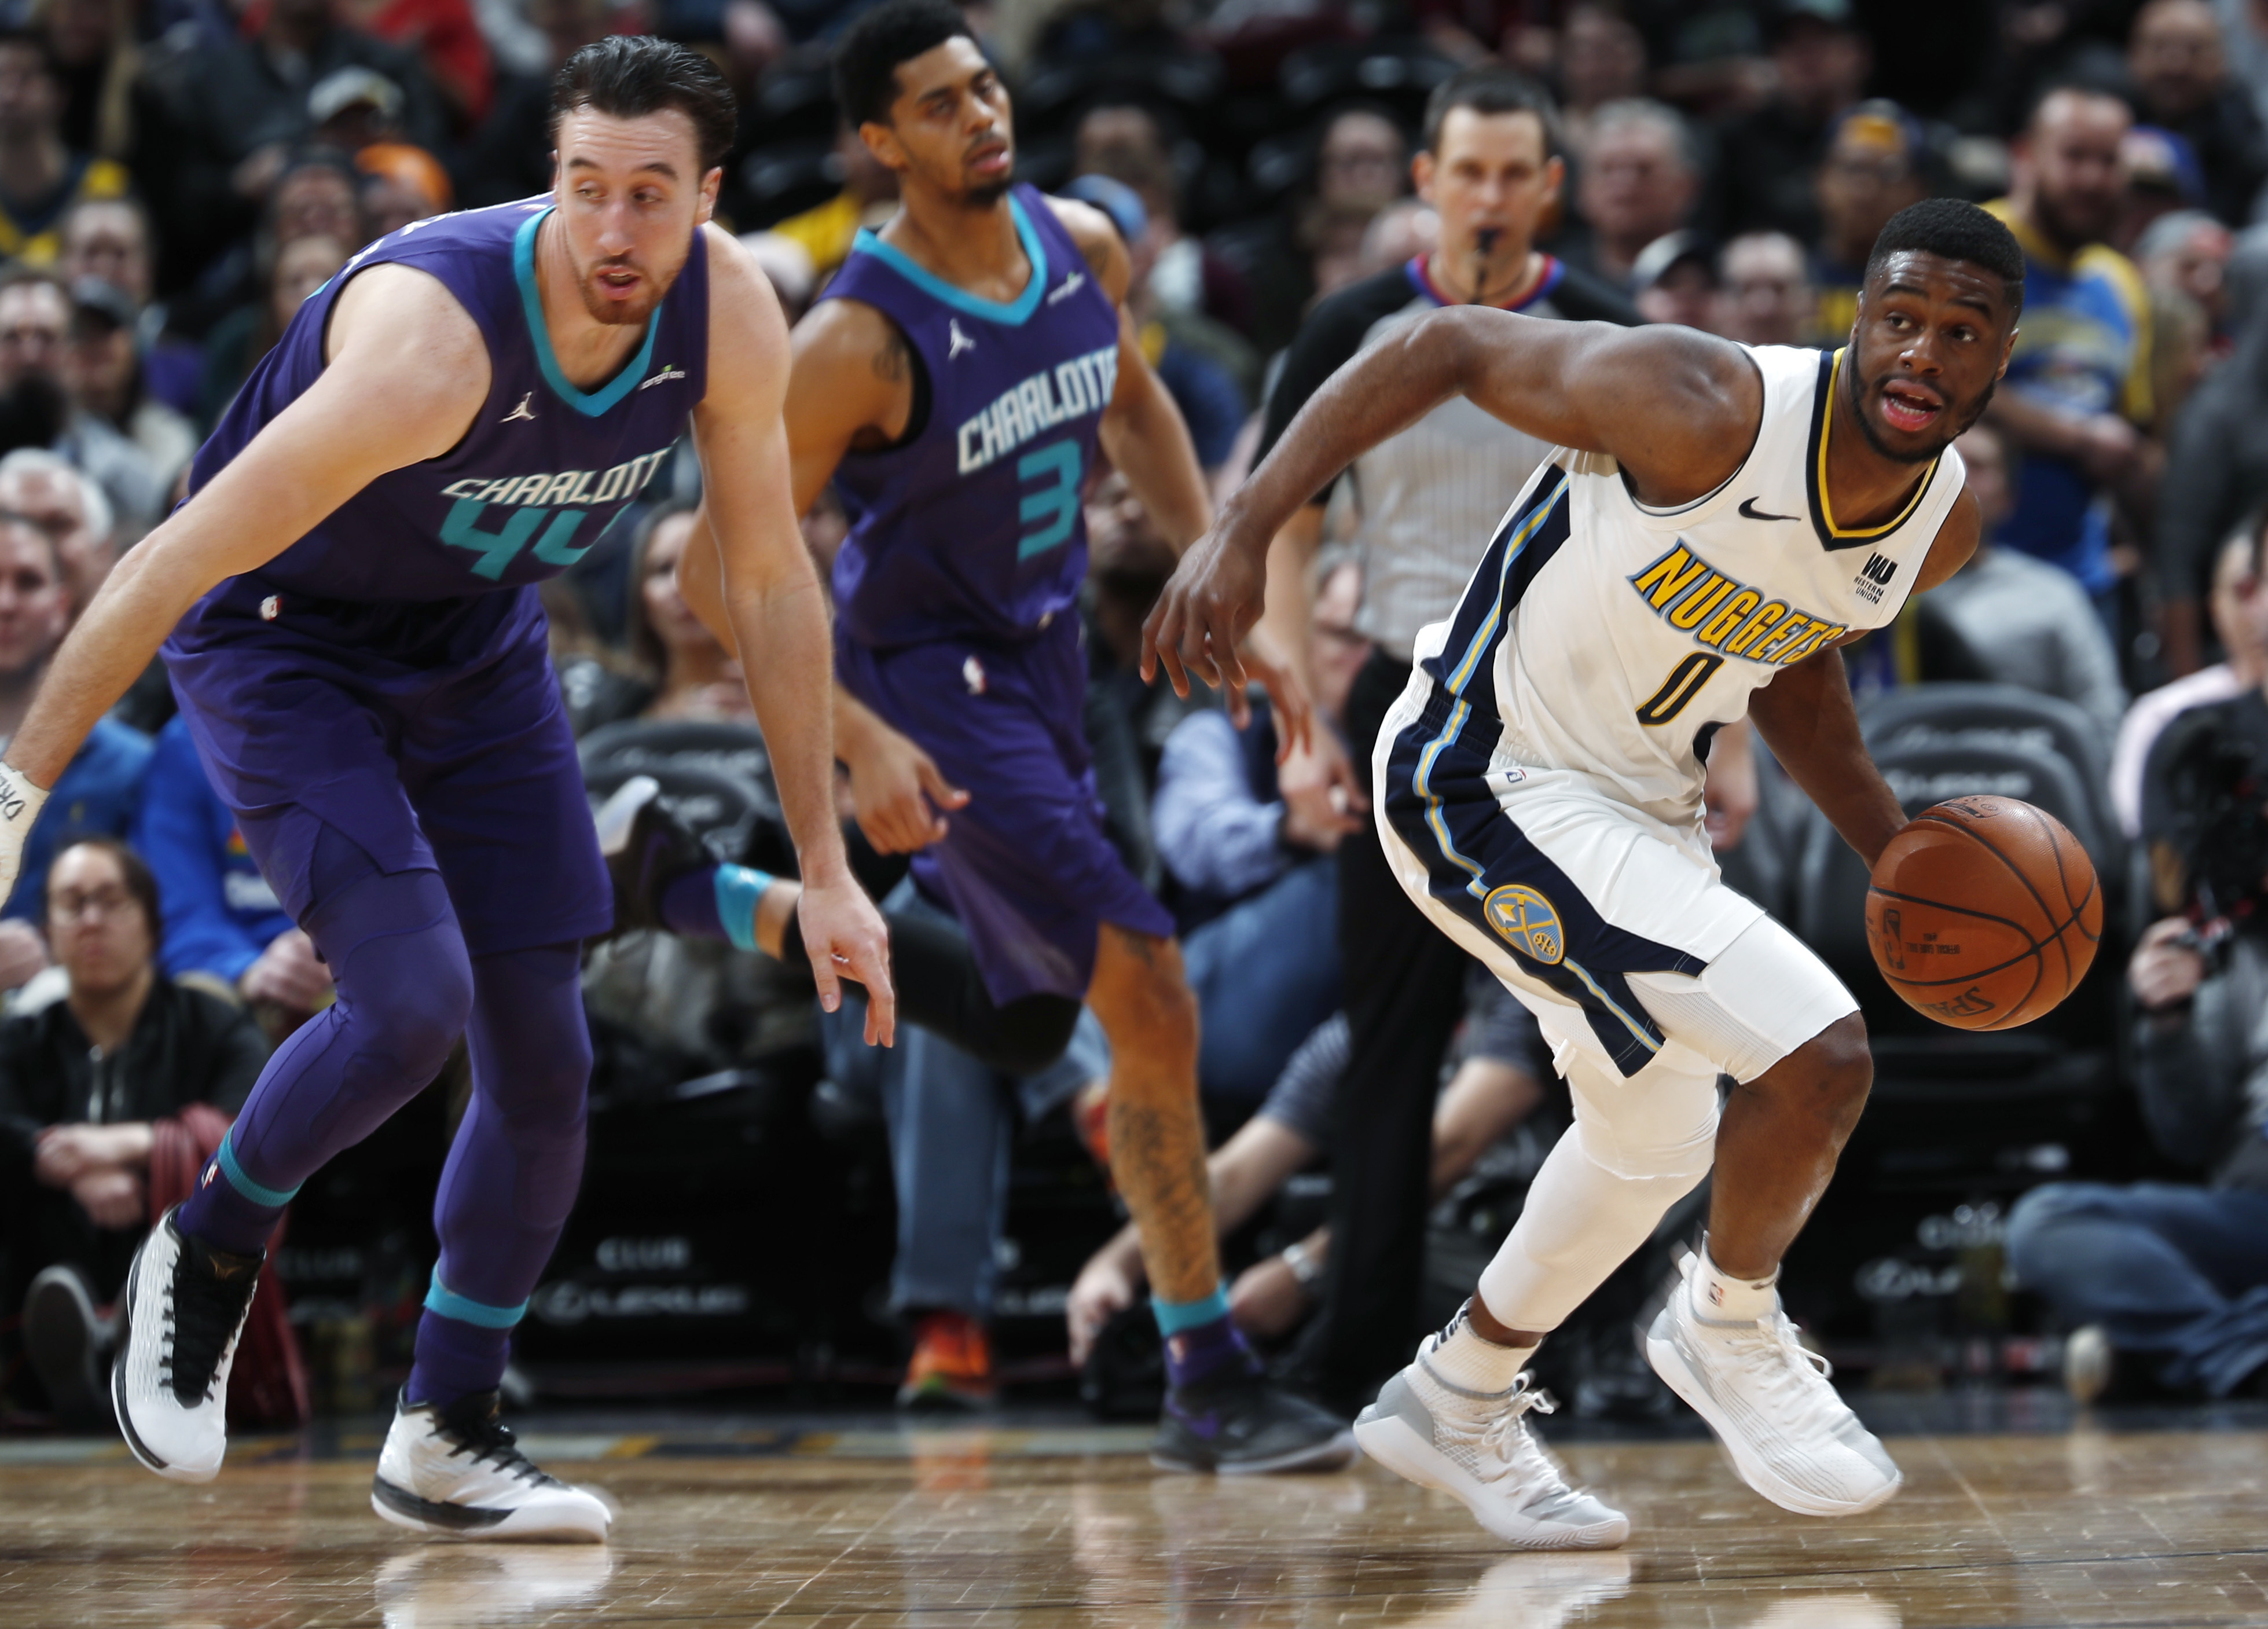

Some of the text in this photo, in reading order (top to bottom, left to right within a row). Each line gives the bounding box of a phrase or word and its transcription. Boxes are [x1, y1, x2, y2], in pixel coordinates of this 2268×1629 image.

[440, 435, 681, 506] CHARLOTT
[1017, 438, 1084, 564] 3
[1625, 537, 1849, 665] NUGGETS
[1853, 575, 1885, 597] WESTERN
[1855, 586, 1880, 605] UNION
[1860, 551, 1899, 585] WU
[1635, 649, 1727, 727] 0
